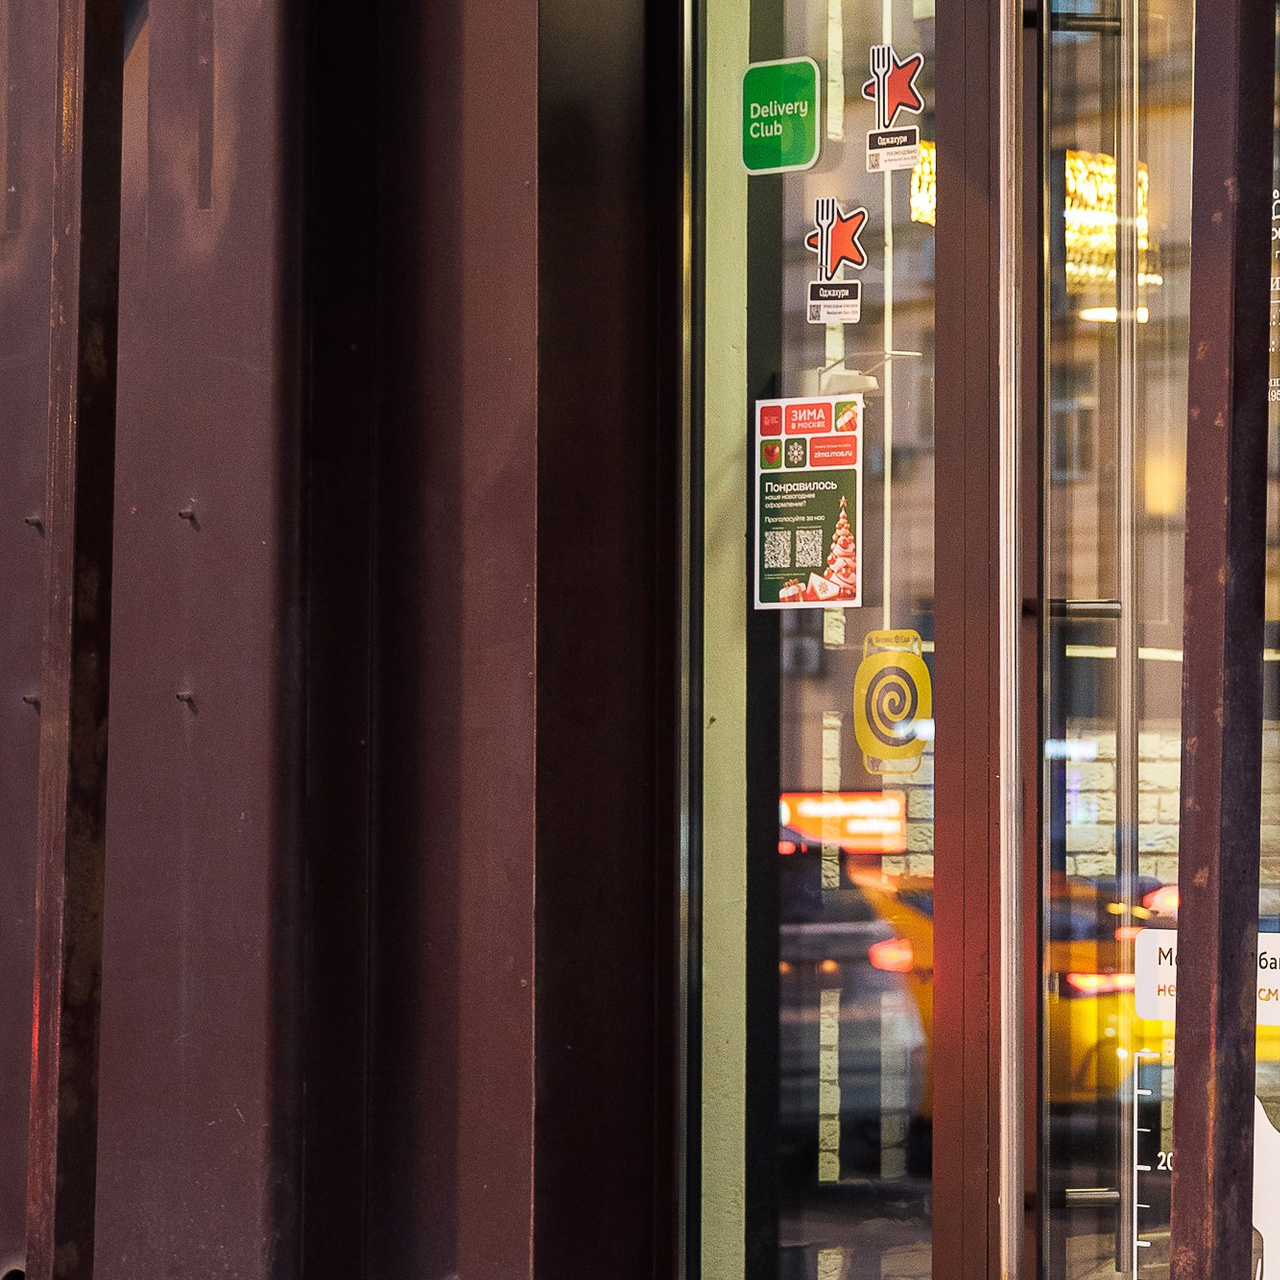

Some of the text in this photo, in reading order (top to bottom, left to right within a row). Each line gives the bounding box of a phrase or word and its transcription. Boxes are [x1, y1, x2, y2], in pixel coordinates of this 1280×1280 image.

[750, 100, 808, 119] Delivery
[750, 120, 783, 139] Club
[877, 135, 908, 146] Оджахури
[819, 287, 850, 299] Оджахури
[791, 408, 826, 422] ЗИМА
[797, 420, 826, 429] МОСКВЕ
[765, 481, 838, 493] Понравилось
